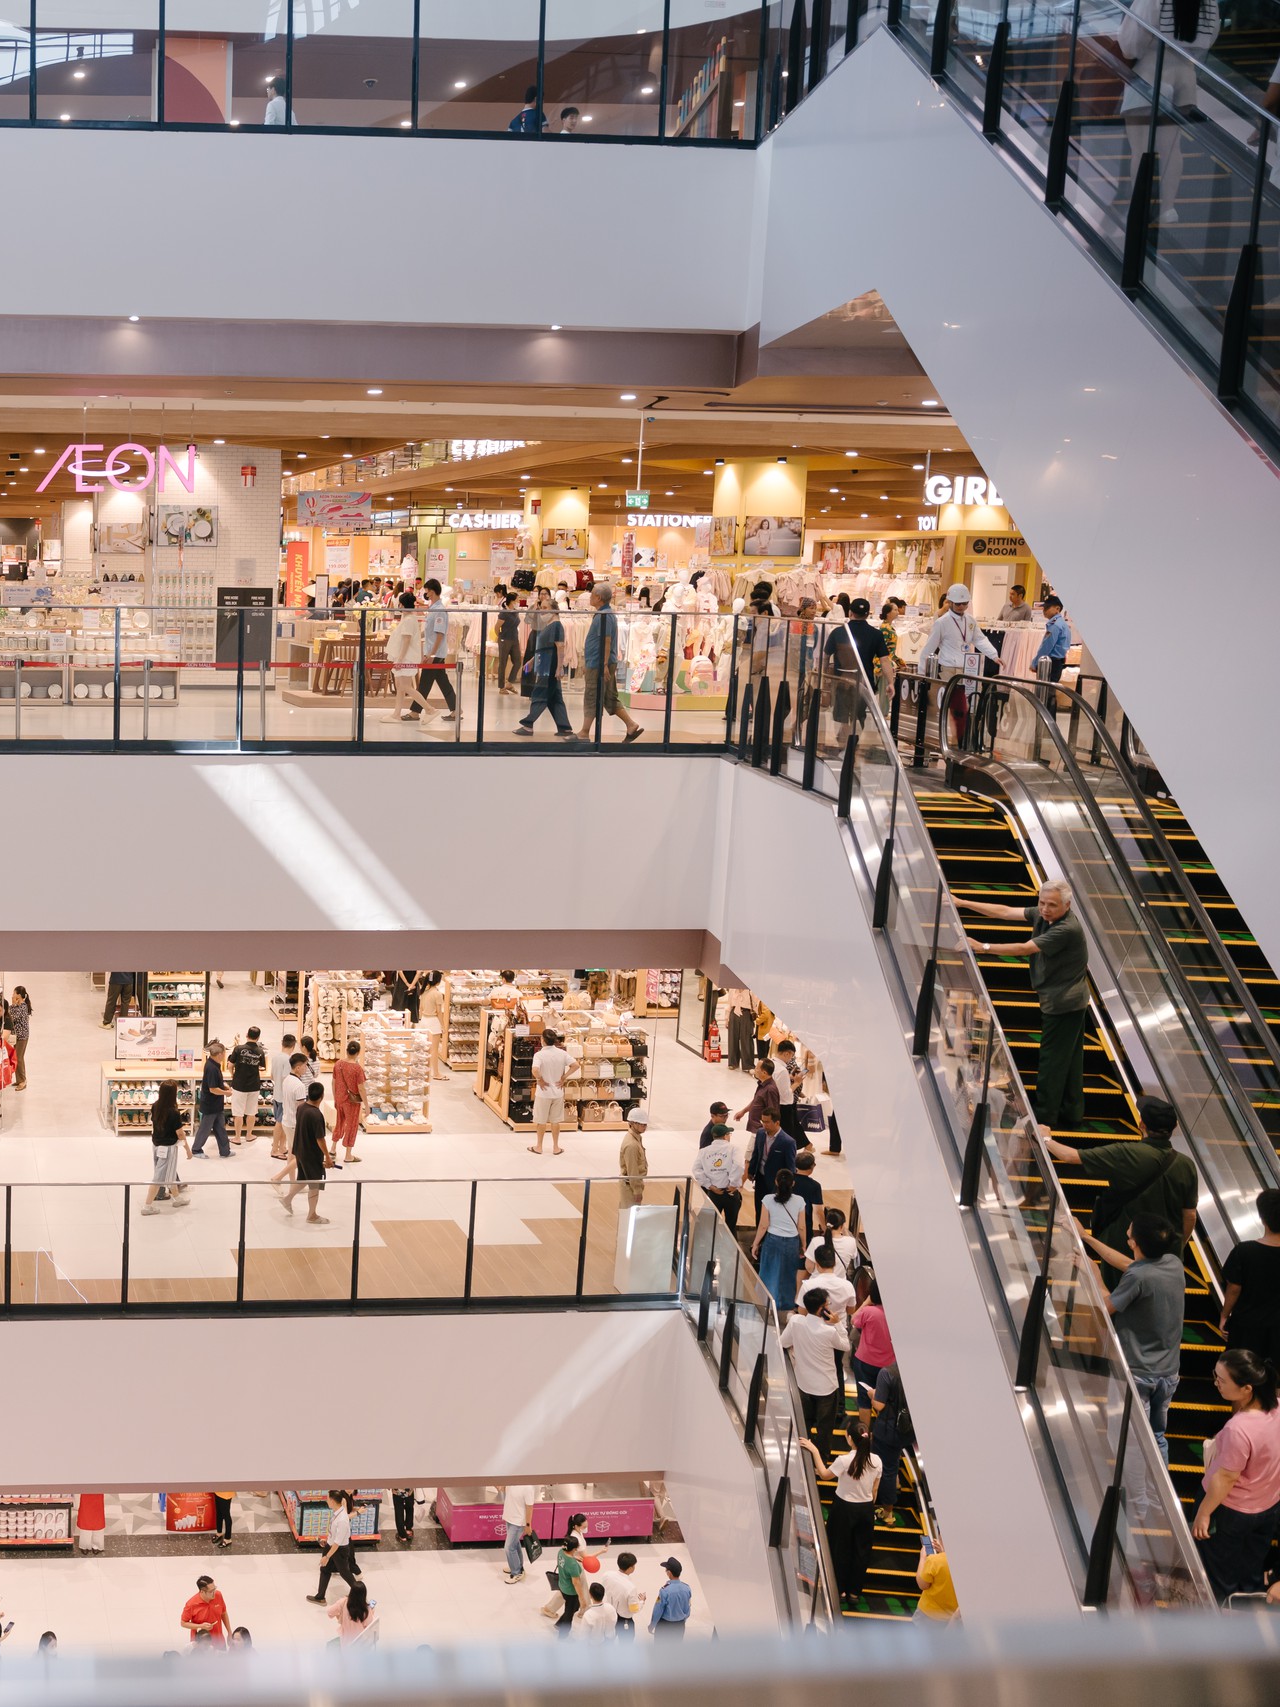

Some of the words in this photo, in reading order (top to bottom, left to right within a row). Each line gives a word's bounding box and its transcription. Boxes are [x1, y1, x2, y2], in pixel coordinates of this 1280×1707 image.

[448, 513, 522, 529] CASHIER
[987, 538, 1025, 546] FITTING
[986, 548, 1017, 556] ROOM
